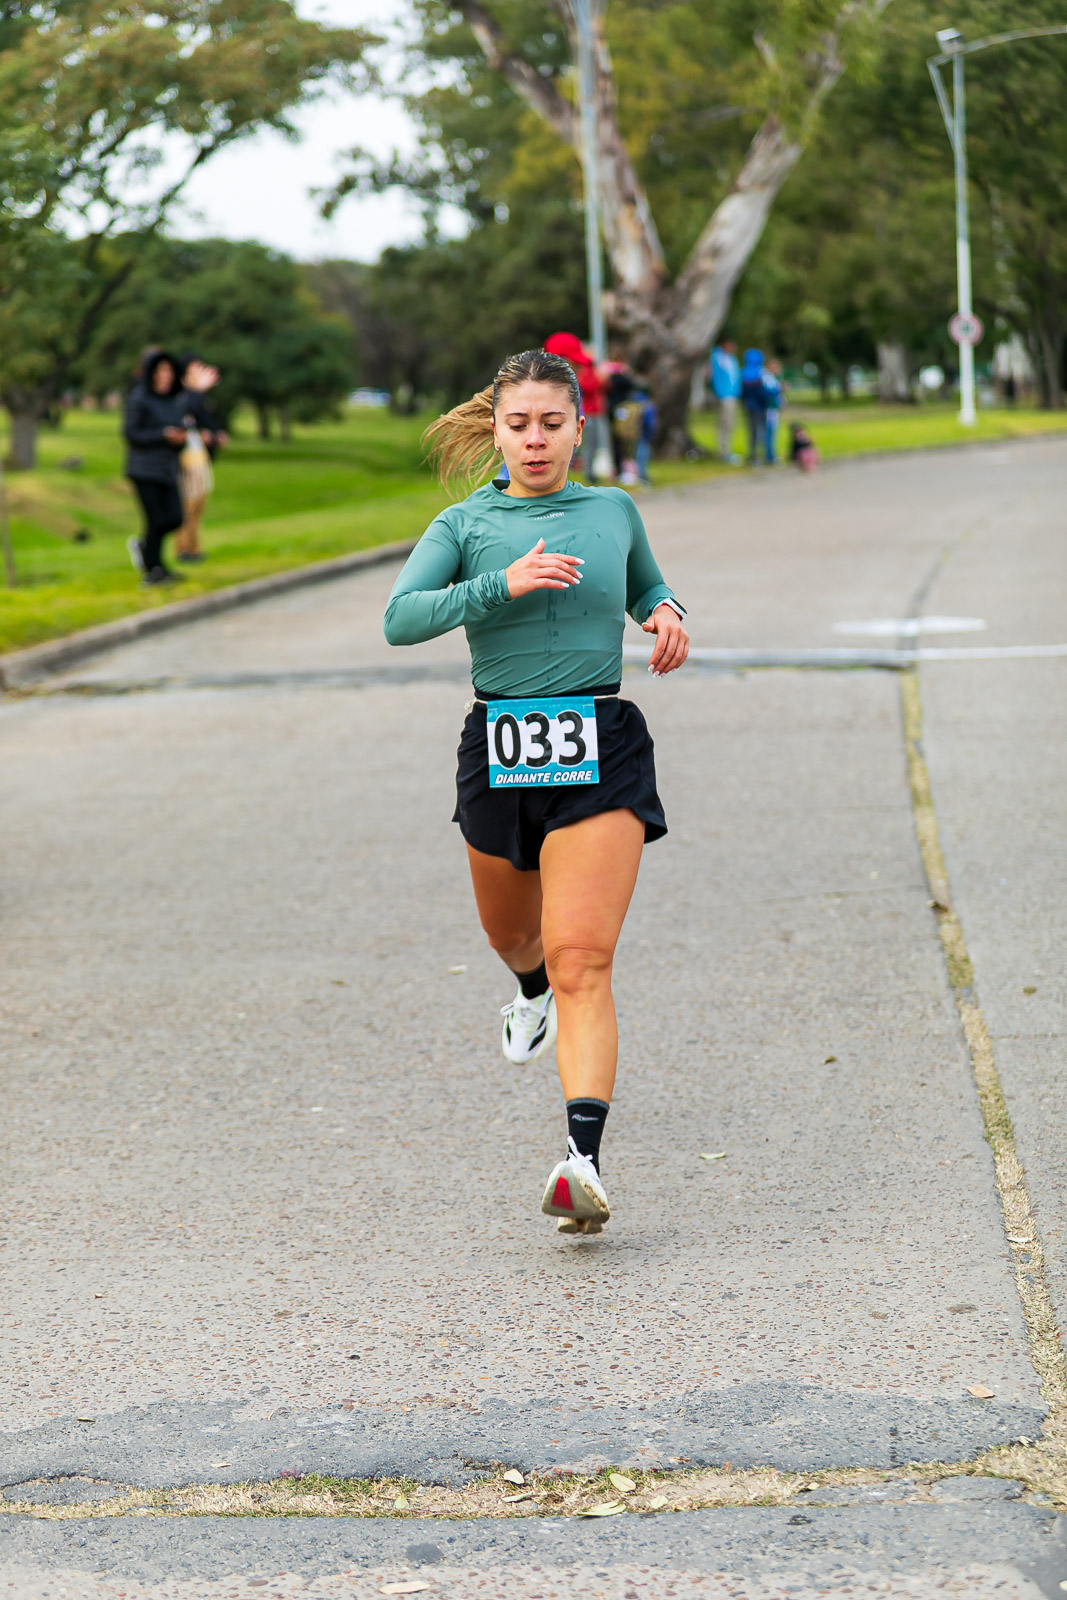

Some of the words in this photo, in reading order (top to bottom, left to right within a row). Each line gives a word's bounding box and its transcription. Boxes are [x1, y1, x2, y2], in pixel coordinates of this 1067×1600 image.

[494, 709, 587, 769] 033
[495, 772, 551, 784] DIAMANTE
[553, 770, 593, 782] CORRE
